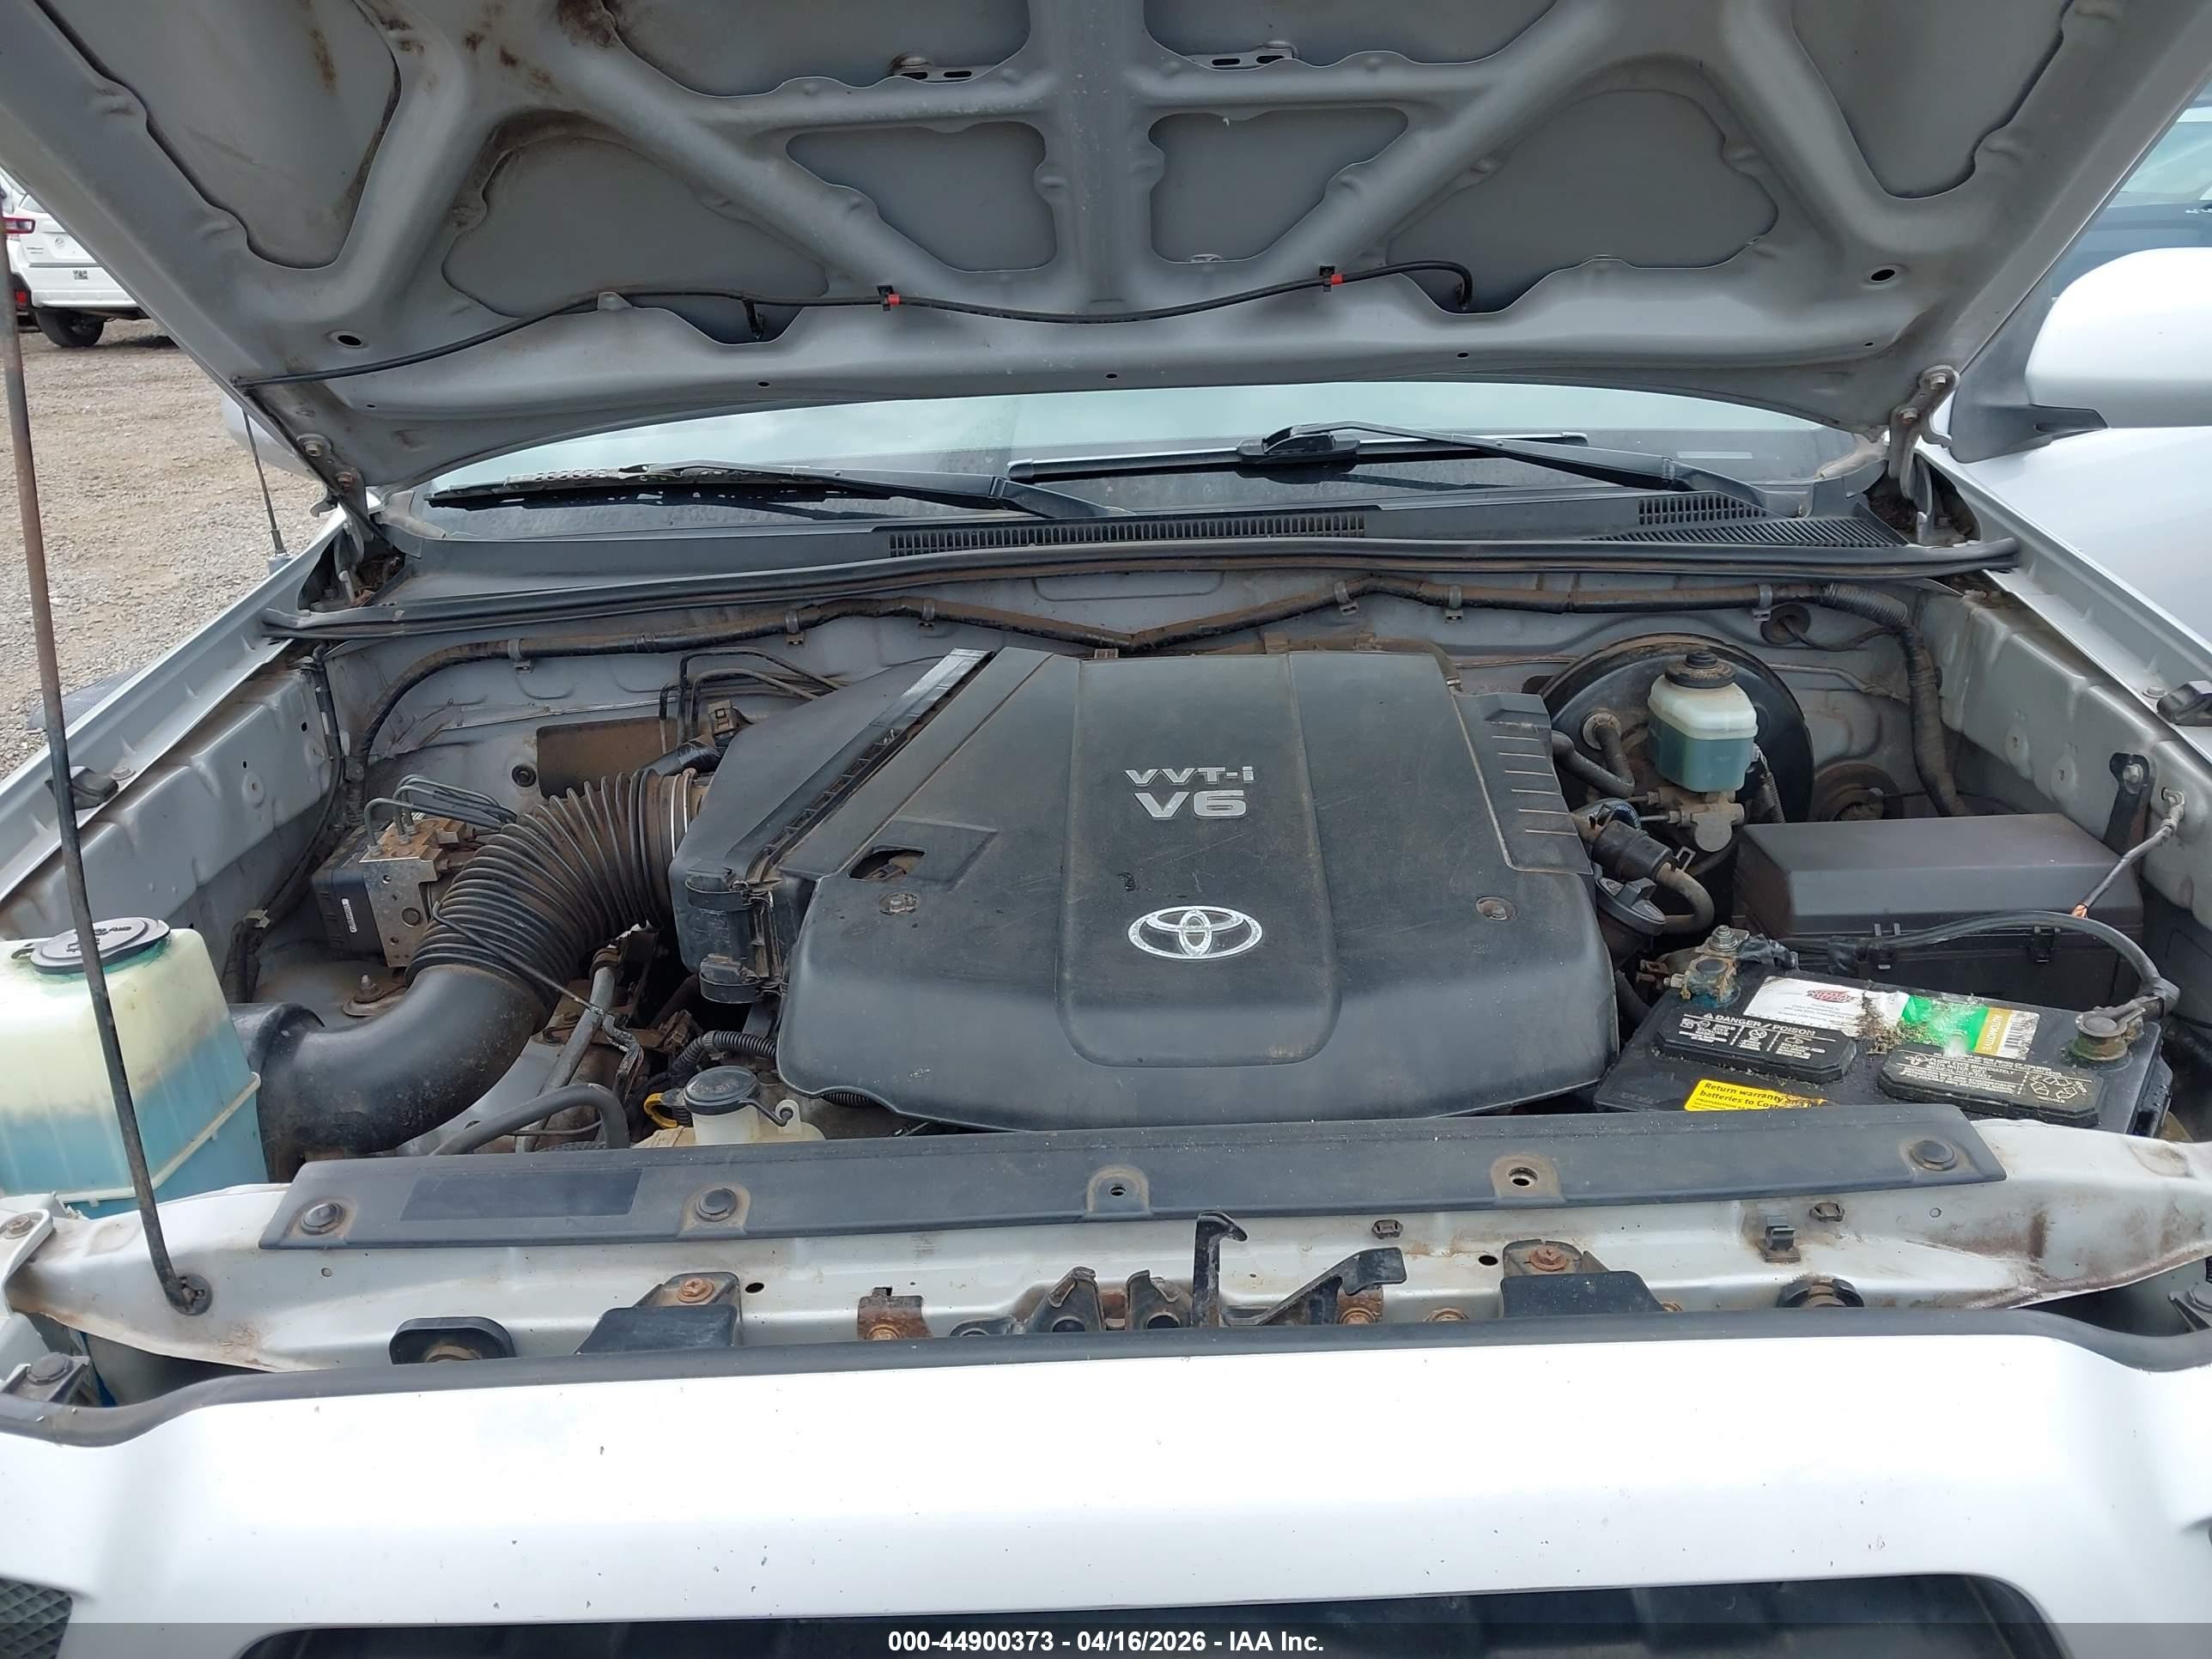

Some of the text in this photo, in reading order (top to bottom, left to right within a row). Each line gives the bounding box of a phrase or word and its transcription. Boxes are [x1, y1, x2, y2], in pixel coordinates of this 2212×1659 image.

[1133, 789, 1249, 820] V6
[1715, 1014, 1760, 1028] DANGER
[1771, 1024, 1816, 1037] POISON
[1982, 1013, 2003, 1051] AUTOMOTIVE
[1699, 1090, 1742, 1104] batteries
[1744, 1097, 1754, 1105] to
[1705, 1082, 1737, 1094] Return
[1739, 1090, 1784, 1103] warranty
